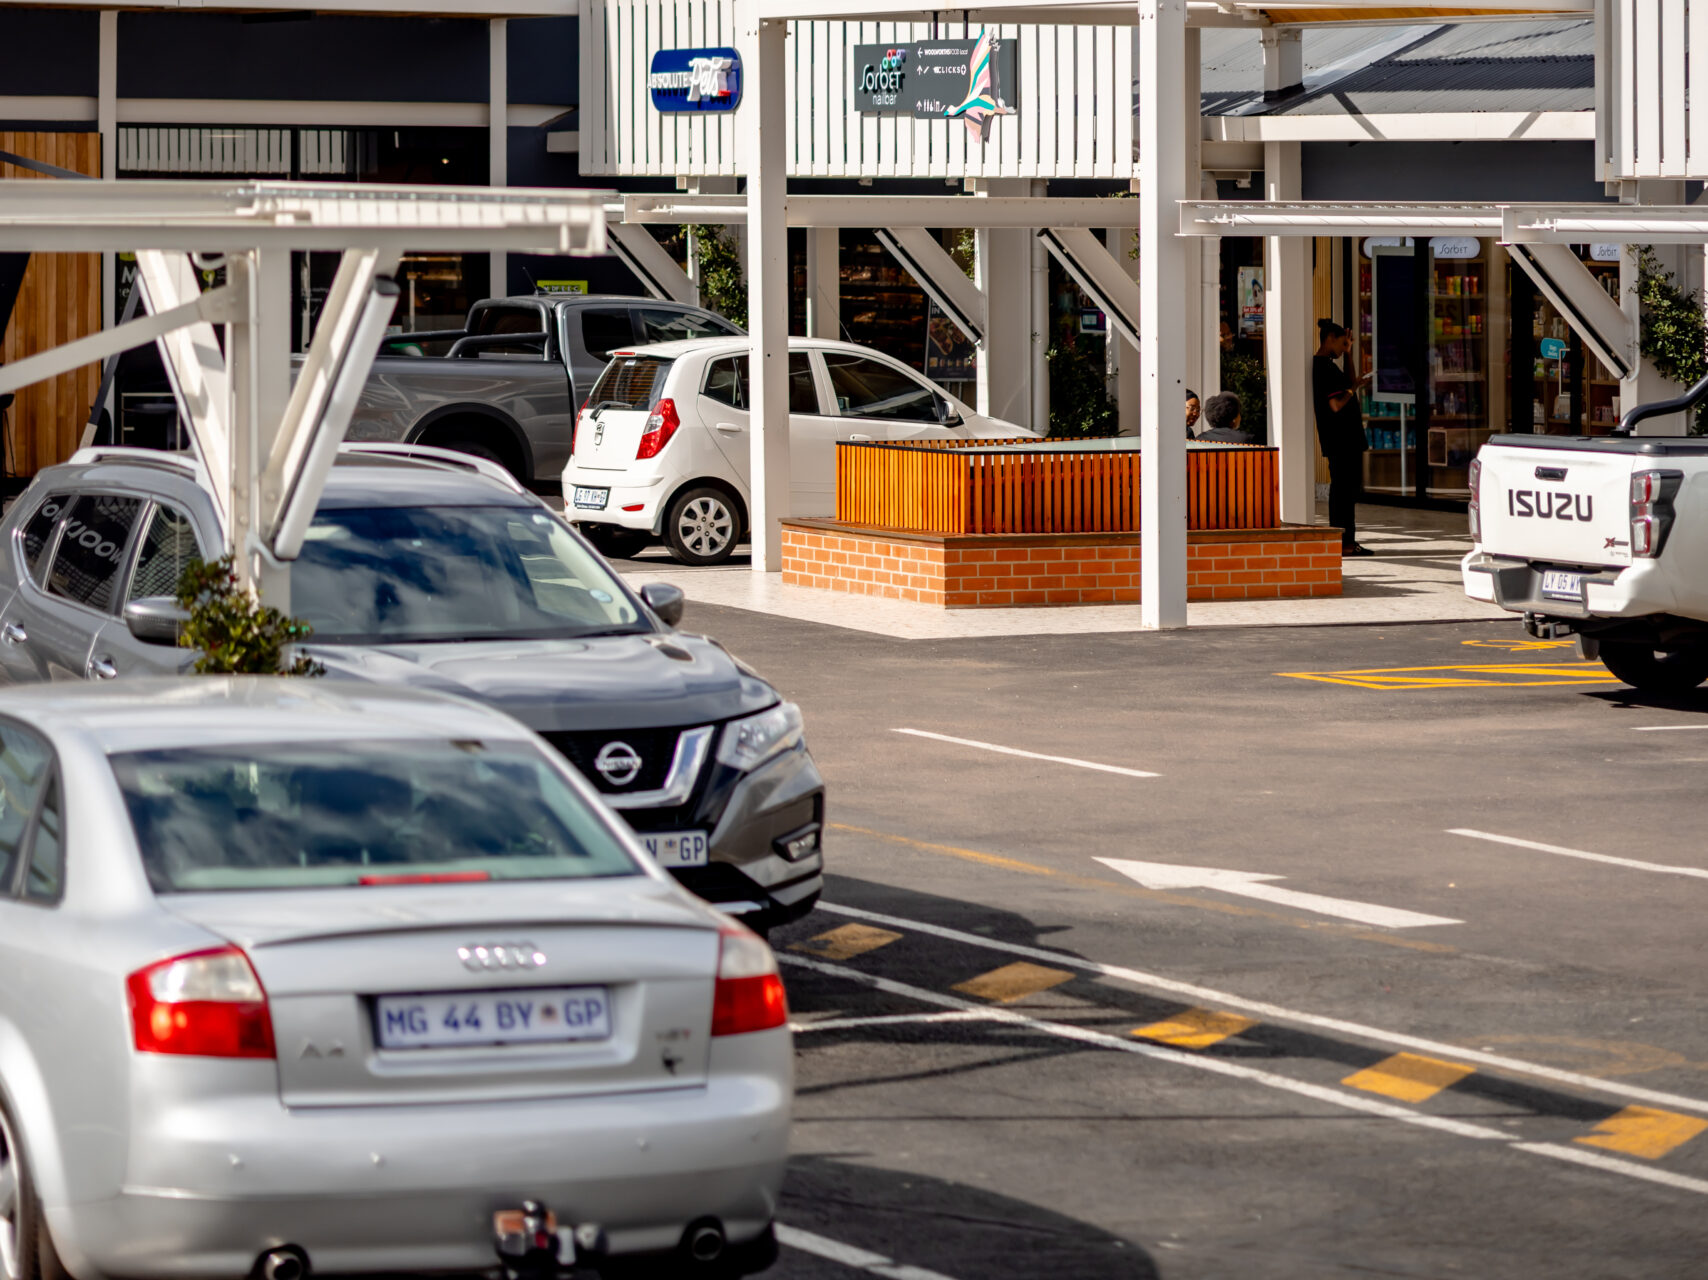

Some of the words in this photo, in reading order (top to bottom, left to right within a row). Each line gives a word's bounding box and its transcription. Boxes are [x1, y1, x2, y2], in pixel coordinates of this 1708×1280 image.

[647, 71, 690, 89] ABSOLUTE
[687, 57, 728, 102] Pets
[872, 93, 897, 105] nailbar
[1508, 488, 1593, 522] ISUZU
[1544, 573, 1556, 590] LY
[680, 836, 704, 861] GP
[386, 1005, 428, 1035] MG
[443, 1003, 482, 1031] 44
[496, 1001, 533, 1030] BY
[563, 998, 602, 1028] GP
